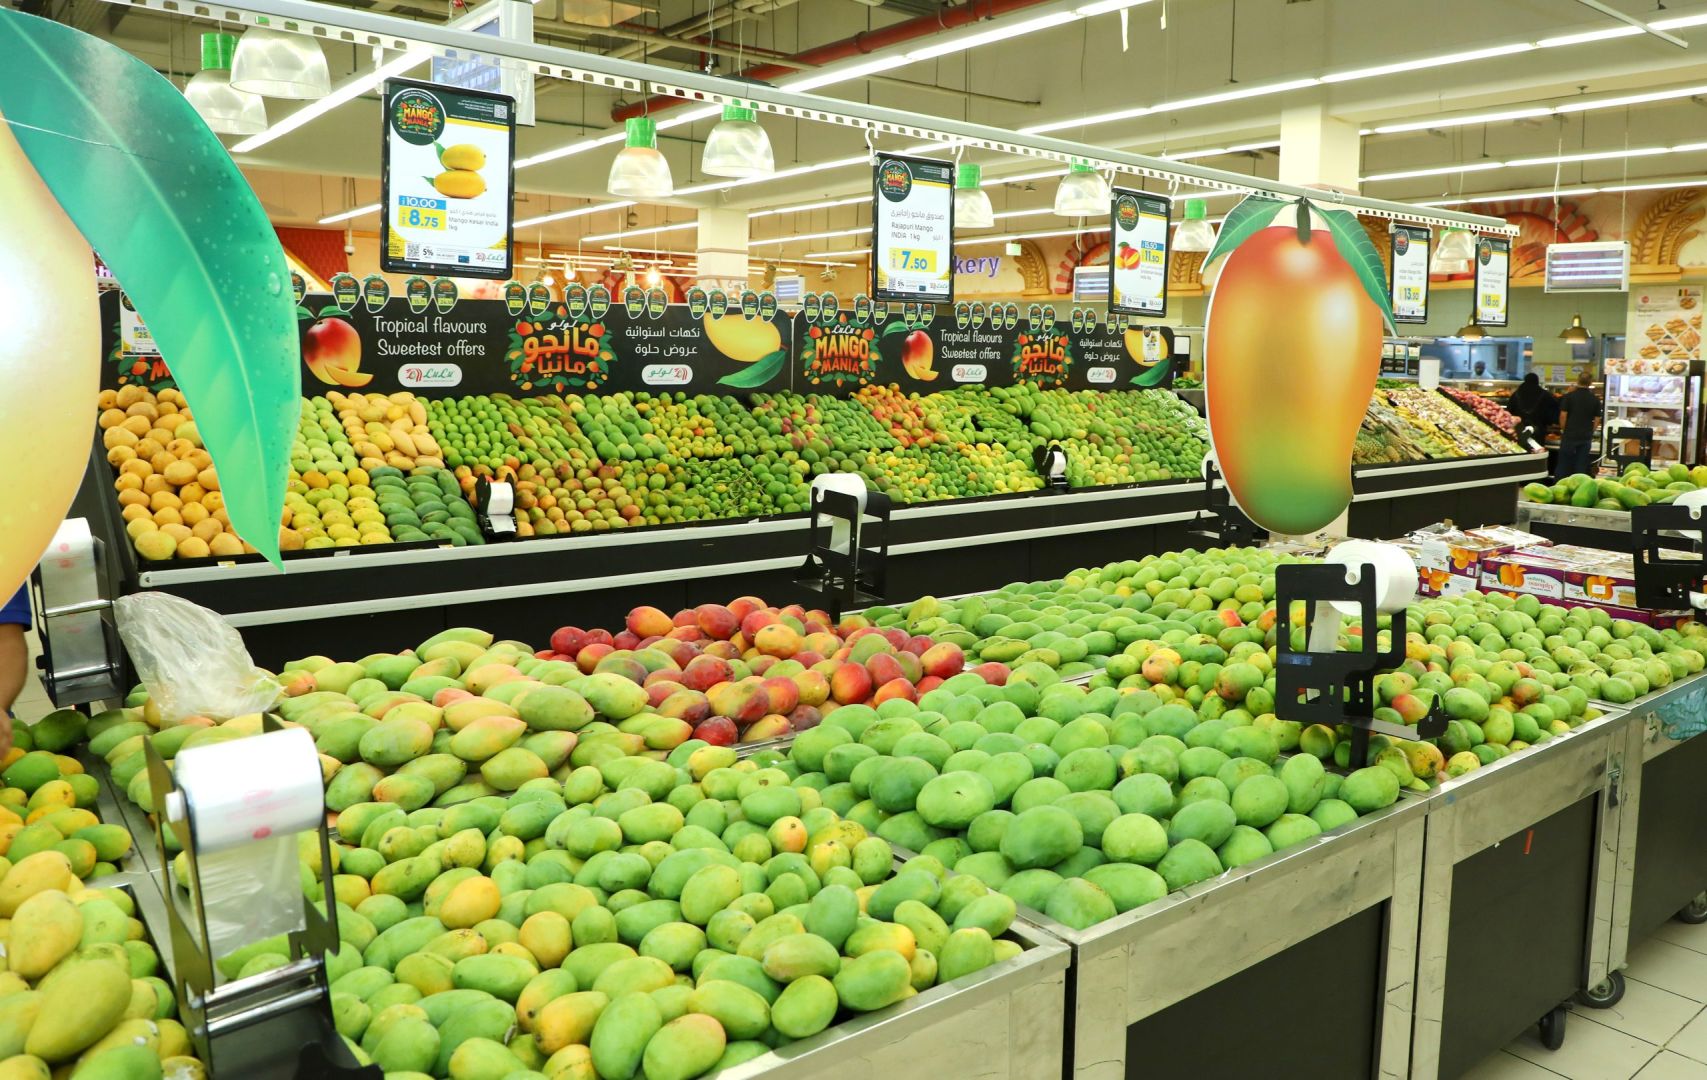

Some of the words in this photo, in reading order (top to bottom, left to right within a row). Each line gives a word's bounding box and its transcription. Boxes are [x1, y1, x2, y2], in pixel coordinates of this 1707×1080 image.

[403, 107, 433, 122] MANGO
[406, 197, 437, 209] 10.00
[409, 209, 439, 228] 8.75
[914, 224, 934, 232] Mango
[422, 248, 434, 256] 5%
[901, 250, 928, 270] 7.50
[373, 315, 428, 338] Tropical
[433, 316, 487, 334] flavours
[546, 319, 578, 331] لولو
[831, 324, 855, 335] LuLu
[625, 326, 666, 340] استوائية
[670, 327, 700, 338] نكهات
[940, 329, 971, 345] Tropical
[972, 330, 1003, 344] flavours
[377, 338, 442, 356] Sweetest
[447, 339, 486, 356] offers
[523, 328, 600, 364] مانجو
[634, 343, 660, 357] حلوة
[663, 343, 698, 357] عروض
[815, 335, 870, 360] MANGO
[1104, 340, 1123, 348] نكهات
[941, 345, 977, 359] Sweetest
[979, 347, 1001, 360] offers
[1021, 338, 1065, 366] مانجو
[1084, 353, 1099, 362] حلوة
[1099, 353, 1121, 362] عروض
[423, 368, 456, 378] LuLu
[820, 358, 860, 375] MANIA
